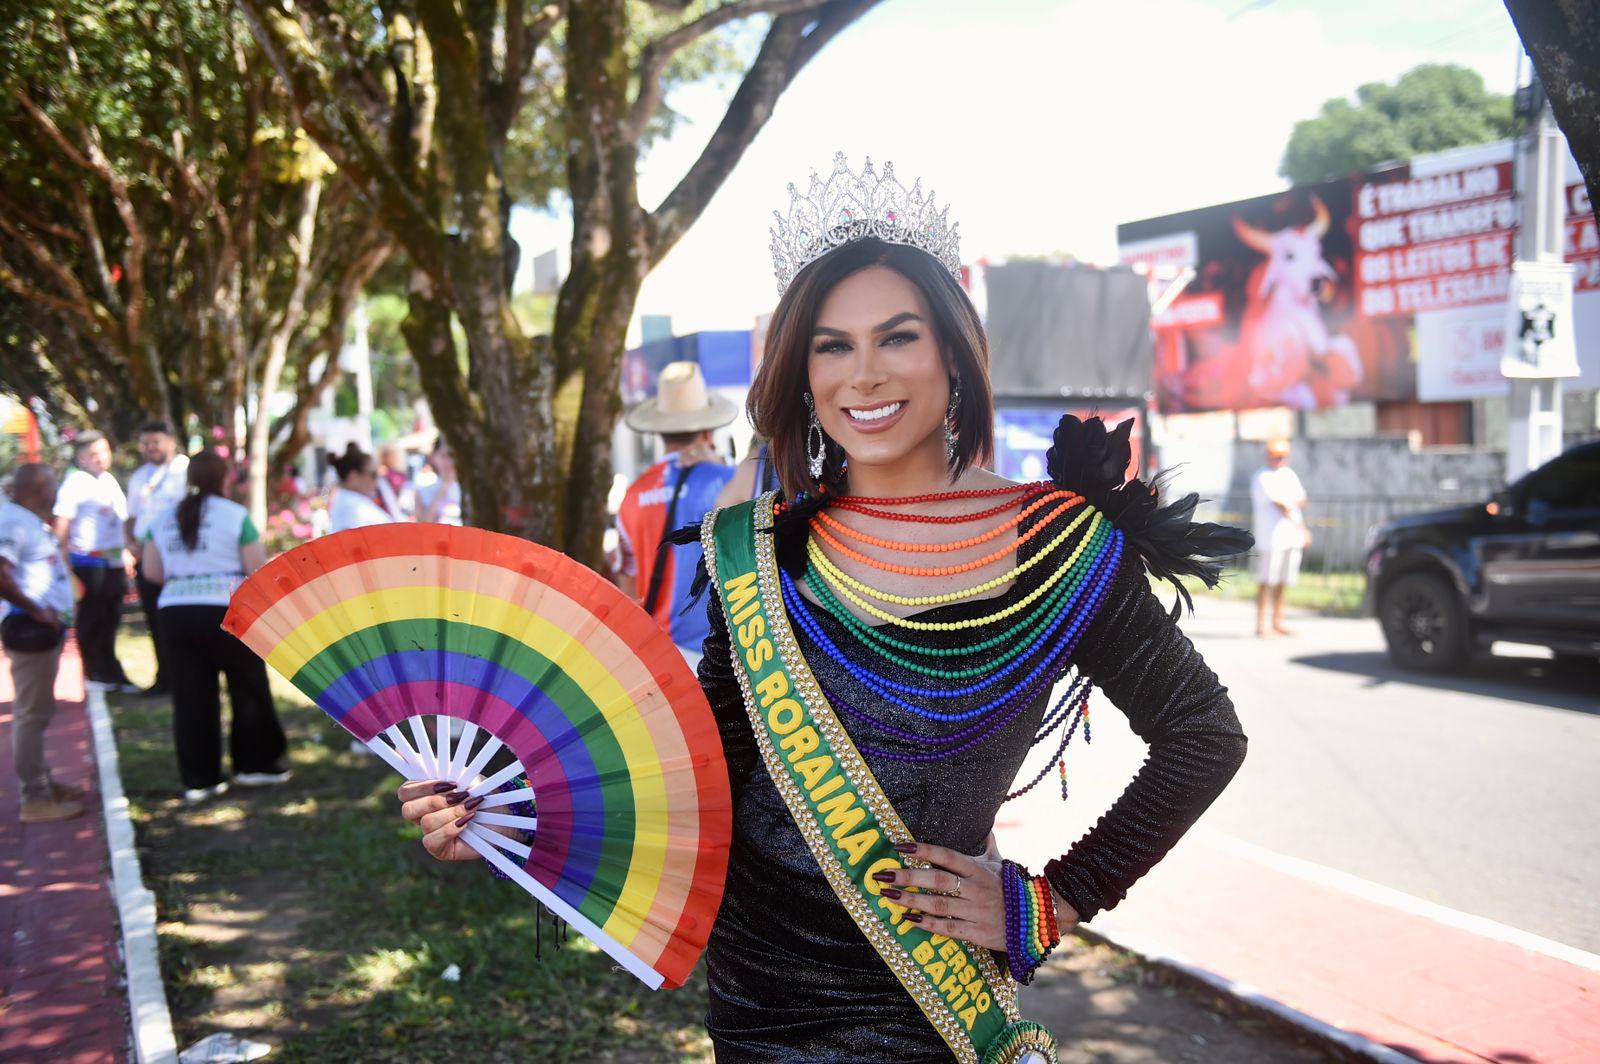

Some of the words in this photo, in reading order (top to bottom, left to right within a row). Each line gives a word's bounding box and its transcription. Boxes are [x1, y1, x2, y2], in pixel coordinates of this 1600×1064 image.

[1378, 167, 1499, 215] TRABALHO
[1360, 215, 1406, 251] QUE
[1393, 240, 1473, 276] LEITOS
[724, 571, 774, 672] MISS
[755, 670, 880, 865] RORAIMA
[912, 940, 977, 1031] BAHIA
